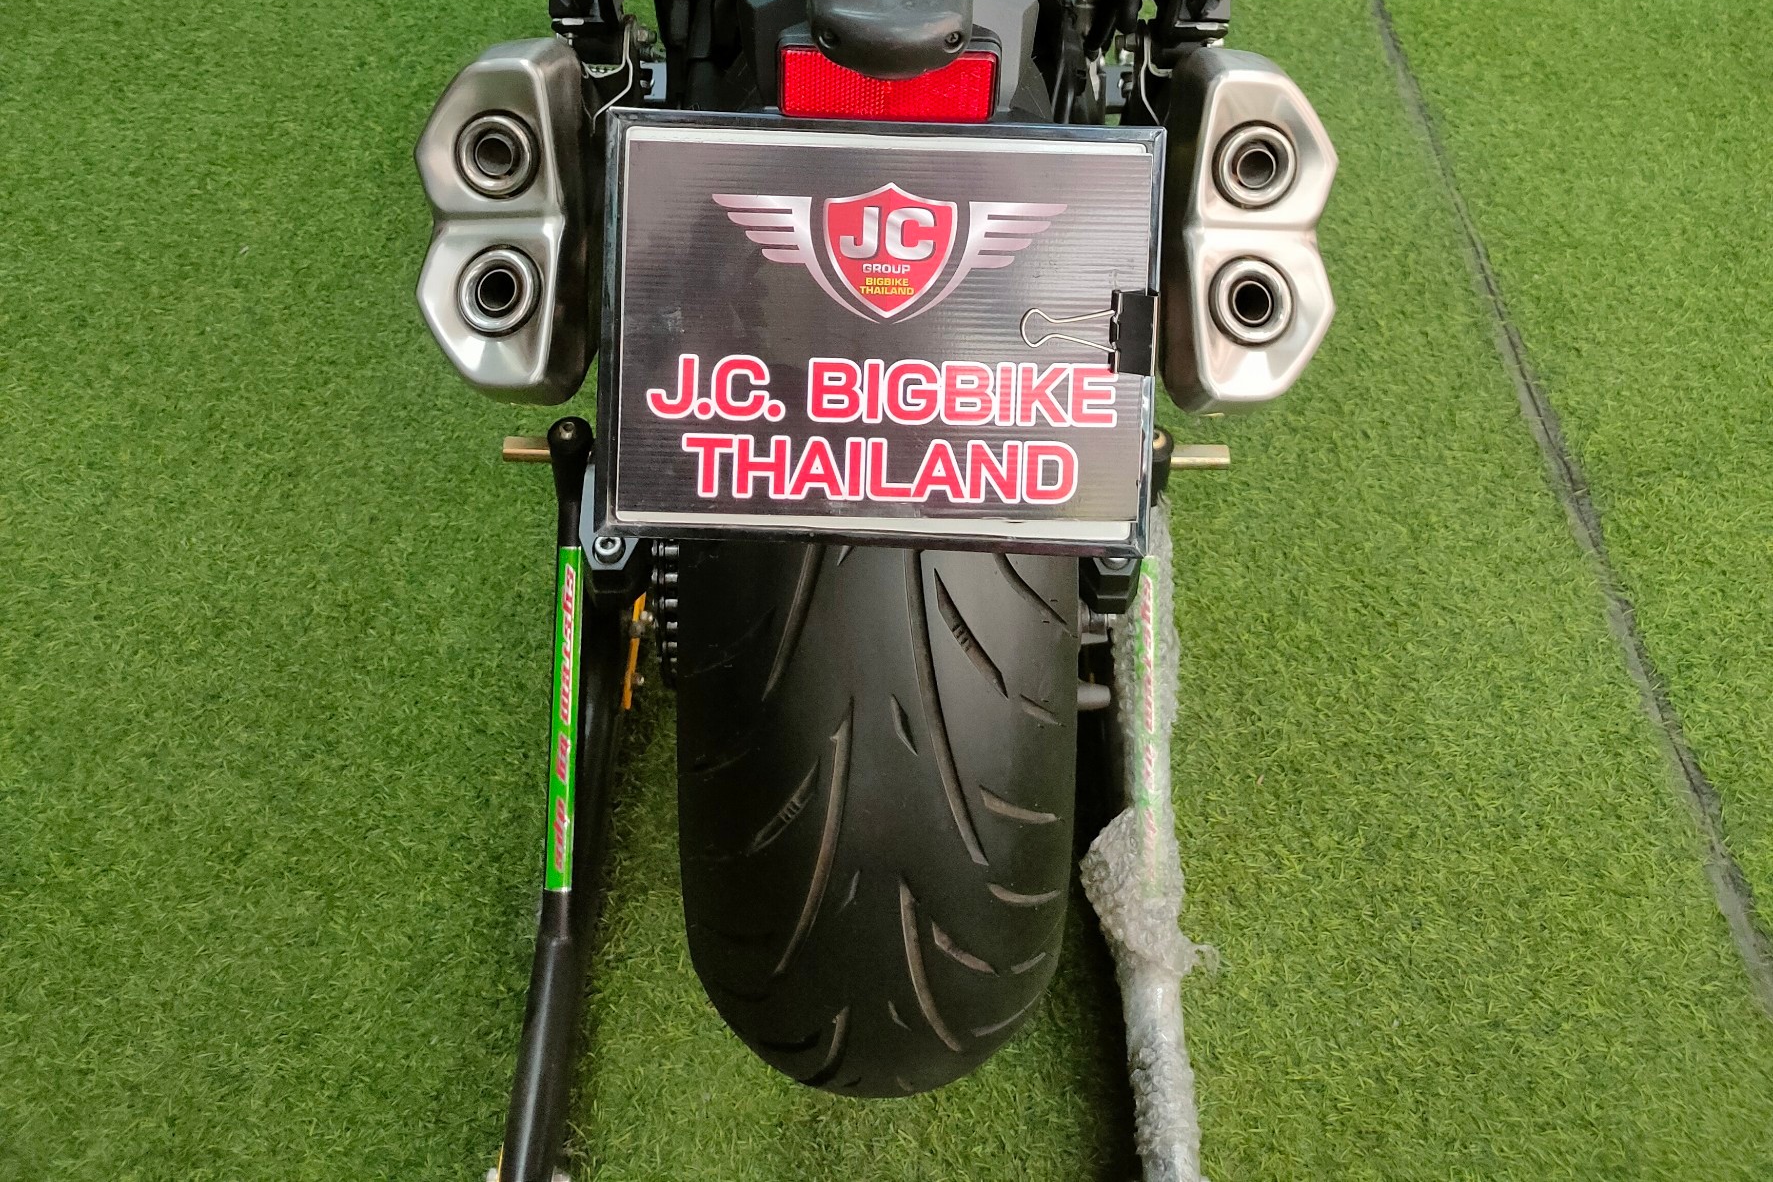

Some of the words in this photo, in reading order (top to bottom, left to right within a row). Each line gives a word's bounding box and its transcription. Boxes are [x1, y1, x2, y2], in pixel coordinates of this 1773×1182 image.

[839, 205, 937, 261] JC
[859, 285, 915, 296] THAILAND
[862, 263, 911, 275] GROUP
[865, 276, 909, 288] BIGBIKE
[646, 354, 786, 422] J.C.
[807, 357, 1118, 428] BIGBIKE
[682, 433, 1079, 505] THAILAND
